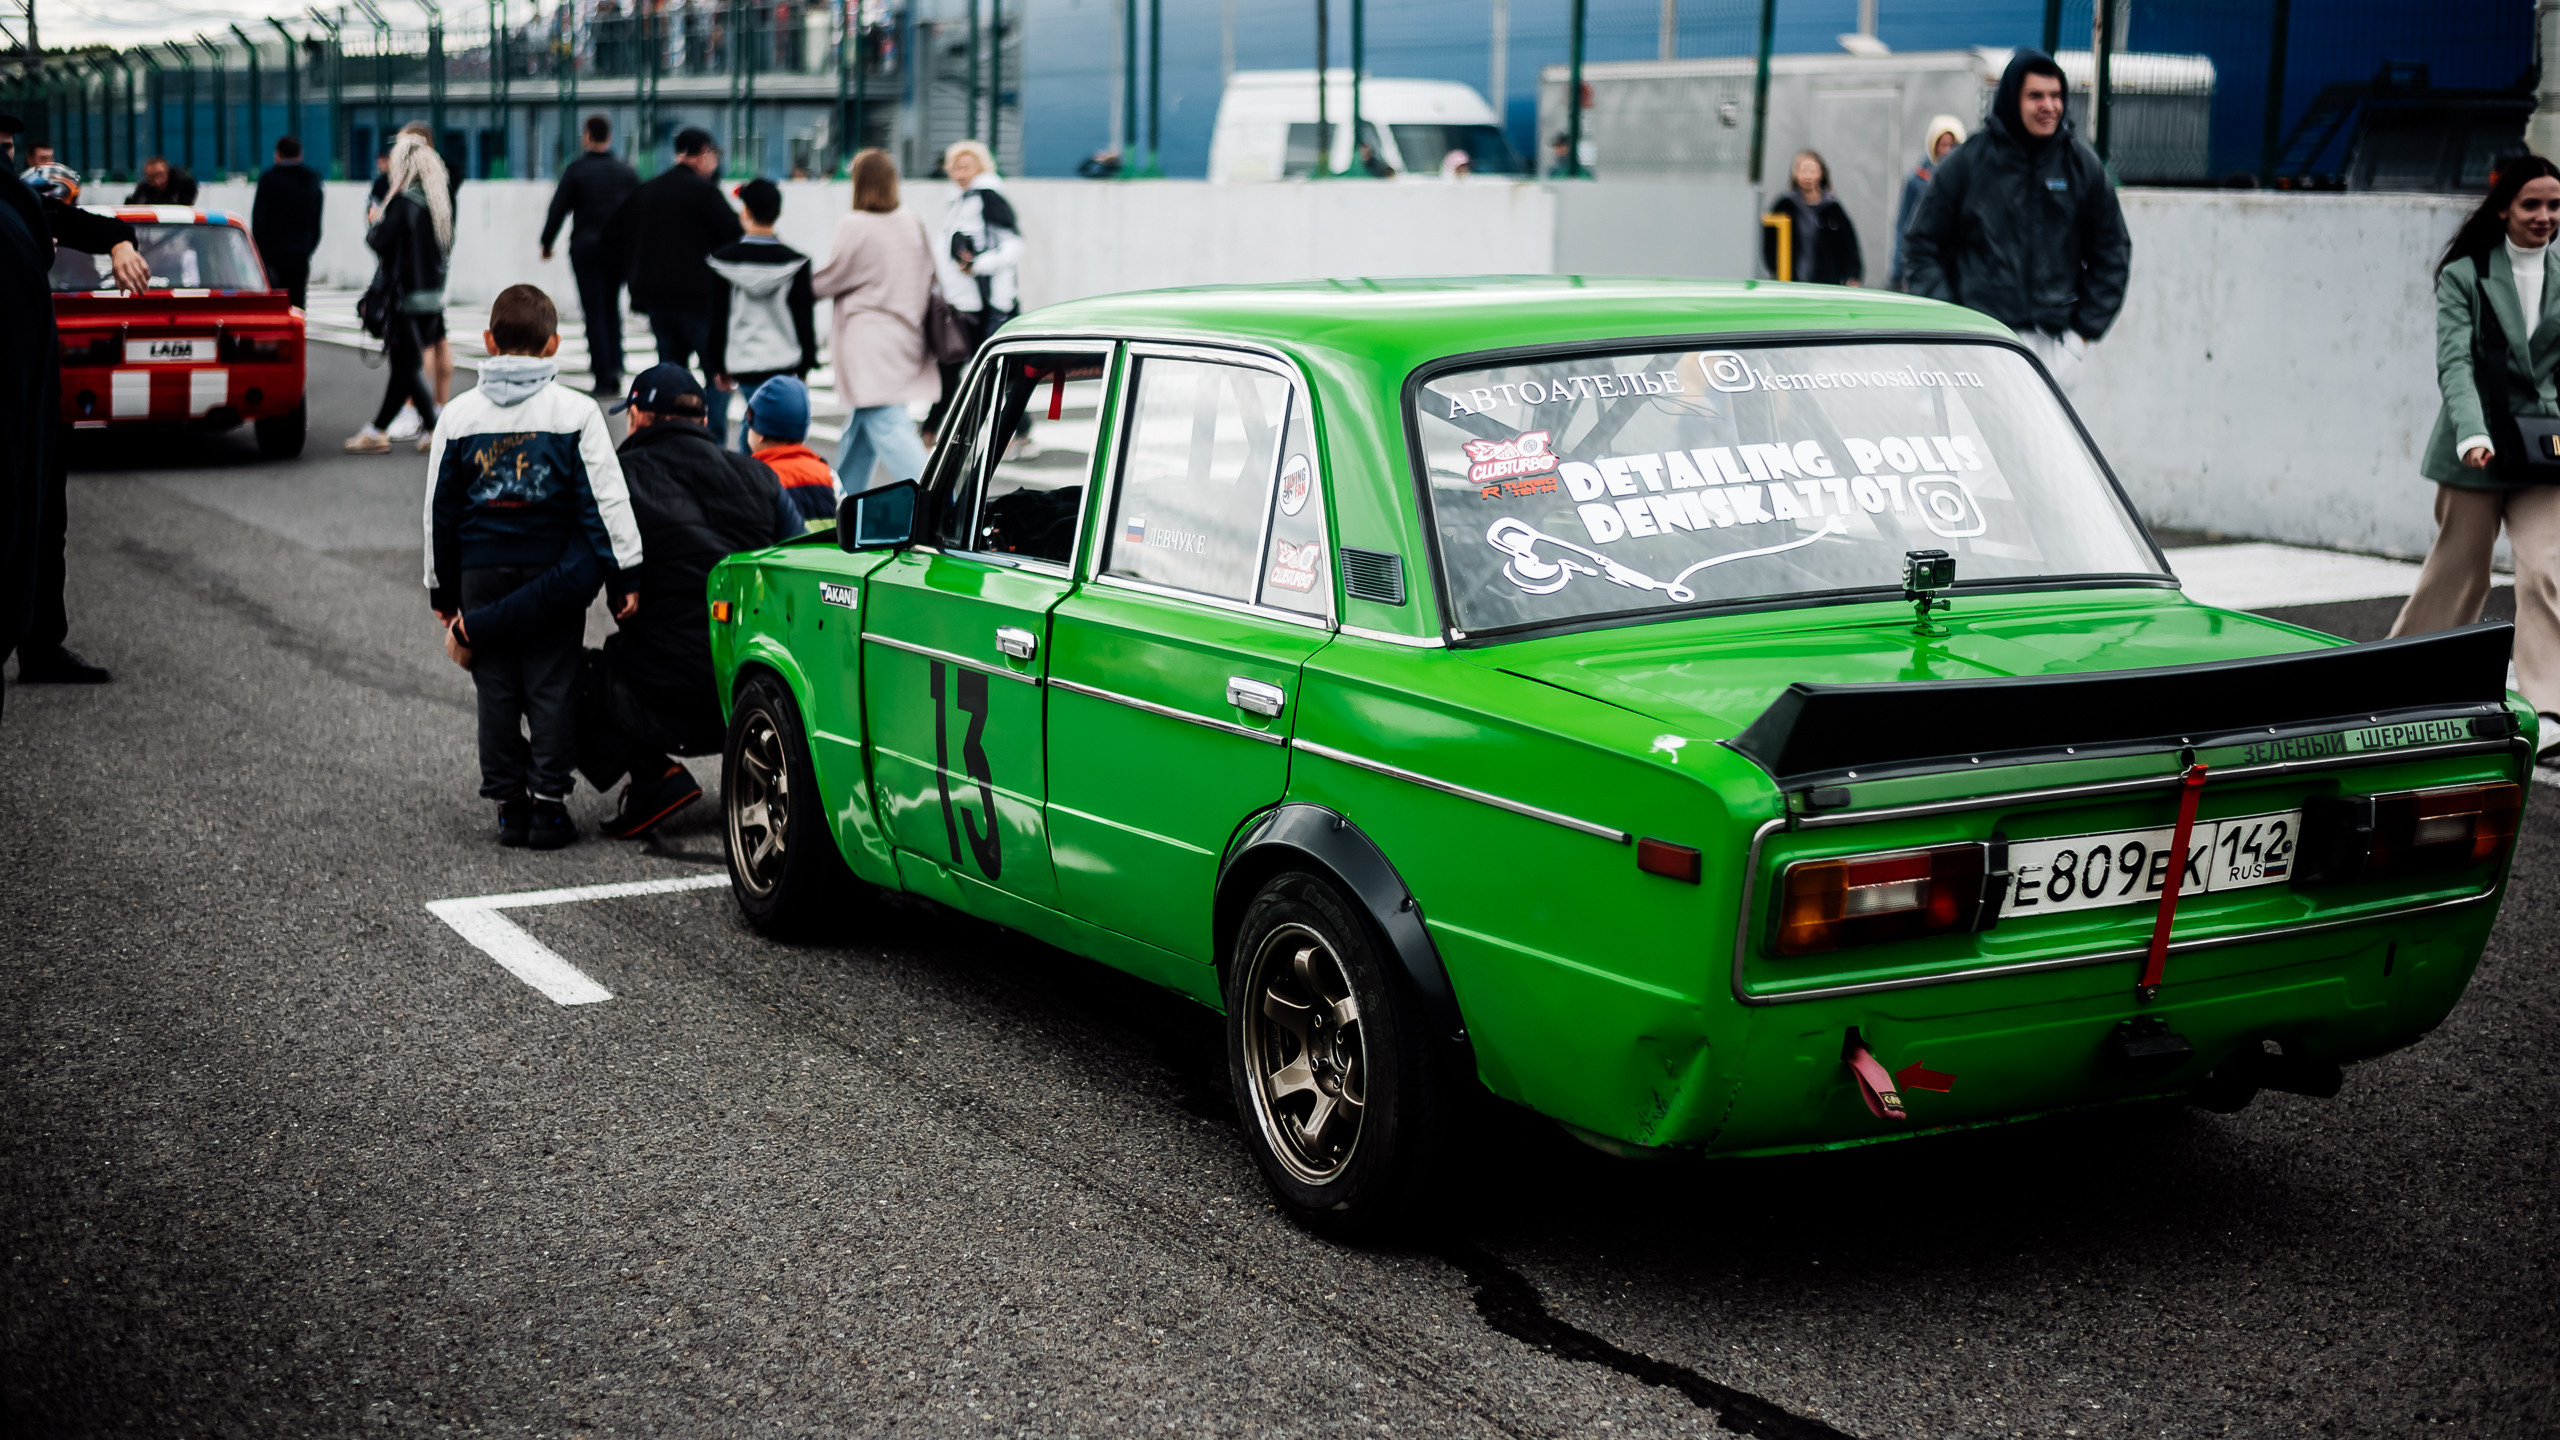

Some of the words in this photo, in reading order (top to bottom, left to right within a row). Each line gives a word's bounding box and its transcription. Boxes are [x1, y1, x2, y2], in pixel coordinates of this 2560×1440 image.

[151, 341, 193, 357] LADA
[1753, 365, 1985, 392] kemerovosalon.ru
[1448, 369, 1685, 420] АВТОАТЕЛЬЕ
[1471, 455, 1557, 482] CLUBTURBO
[1557, 440, 1836, 503] DETAILING
[1843, 435, 1983, 477] POLIS
[1294, 481, 1306, 499] FAN
[1577, 475, 1907, 545] DENISKA7707
[1147, 528, 1197, 553] ЛЕВЧУК
[2360, 720, 2464, 749] ШЕРШЕНЬ
[930, 659, 1001, 881] 13
[2220, 820, 2287, 867] 142
[2229, 862, 2263, 882] RUS
